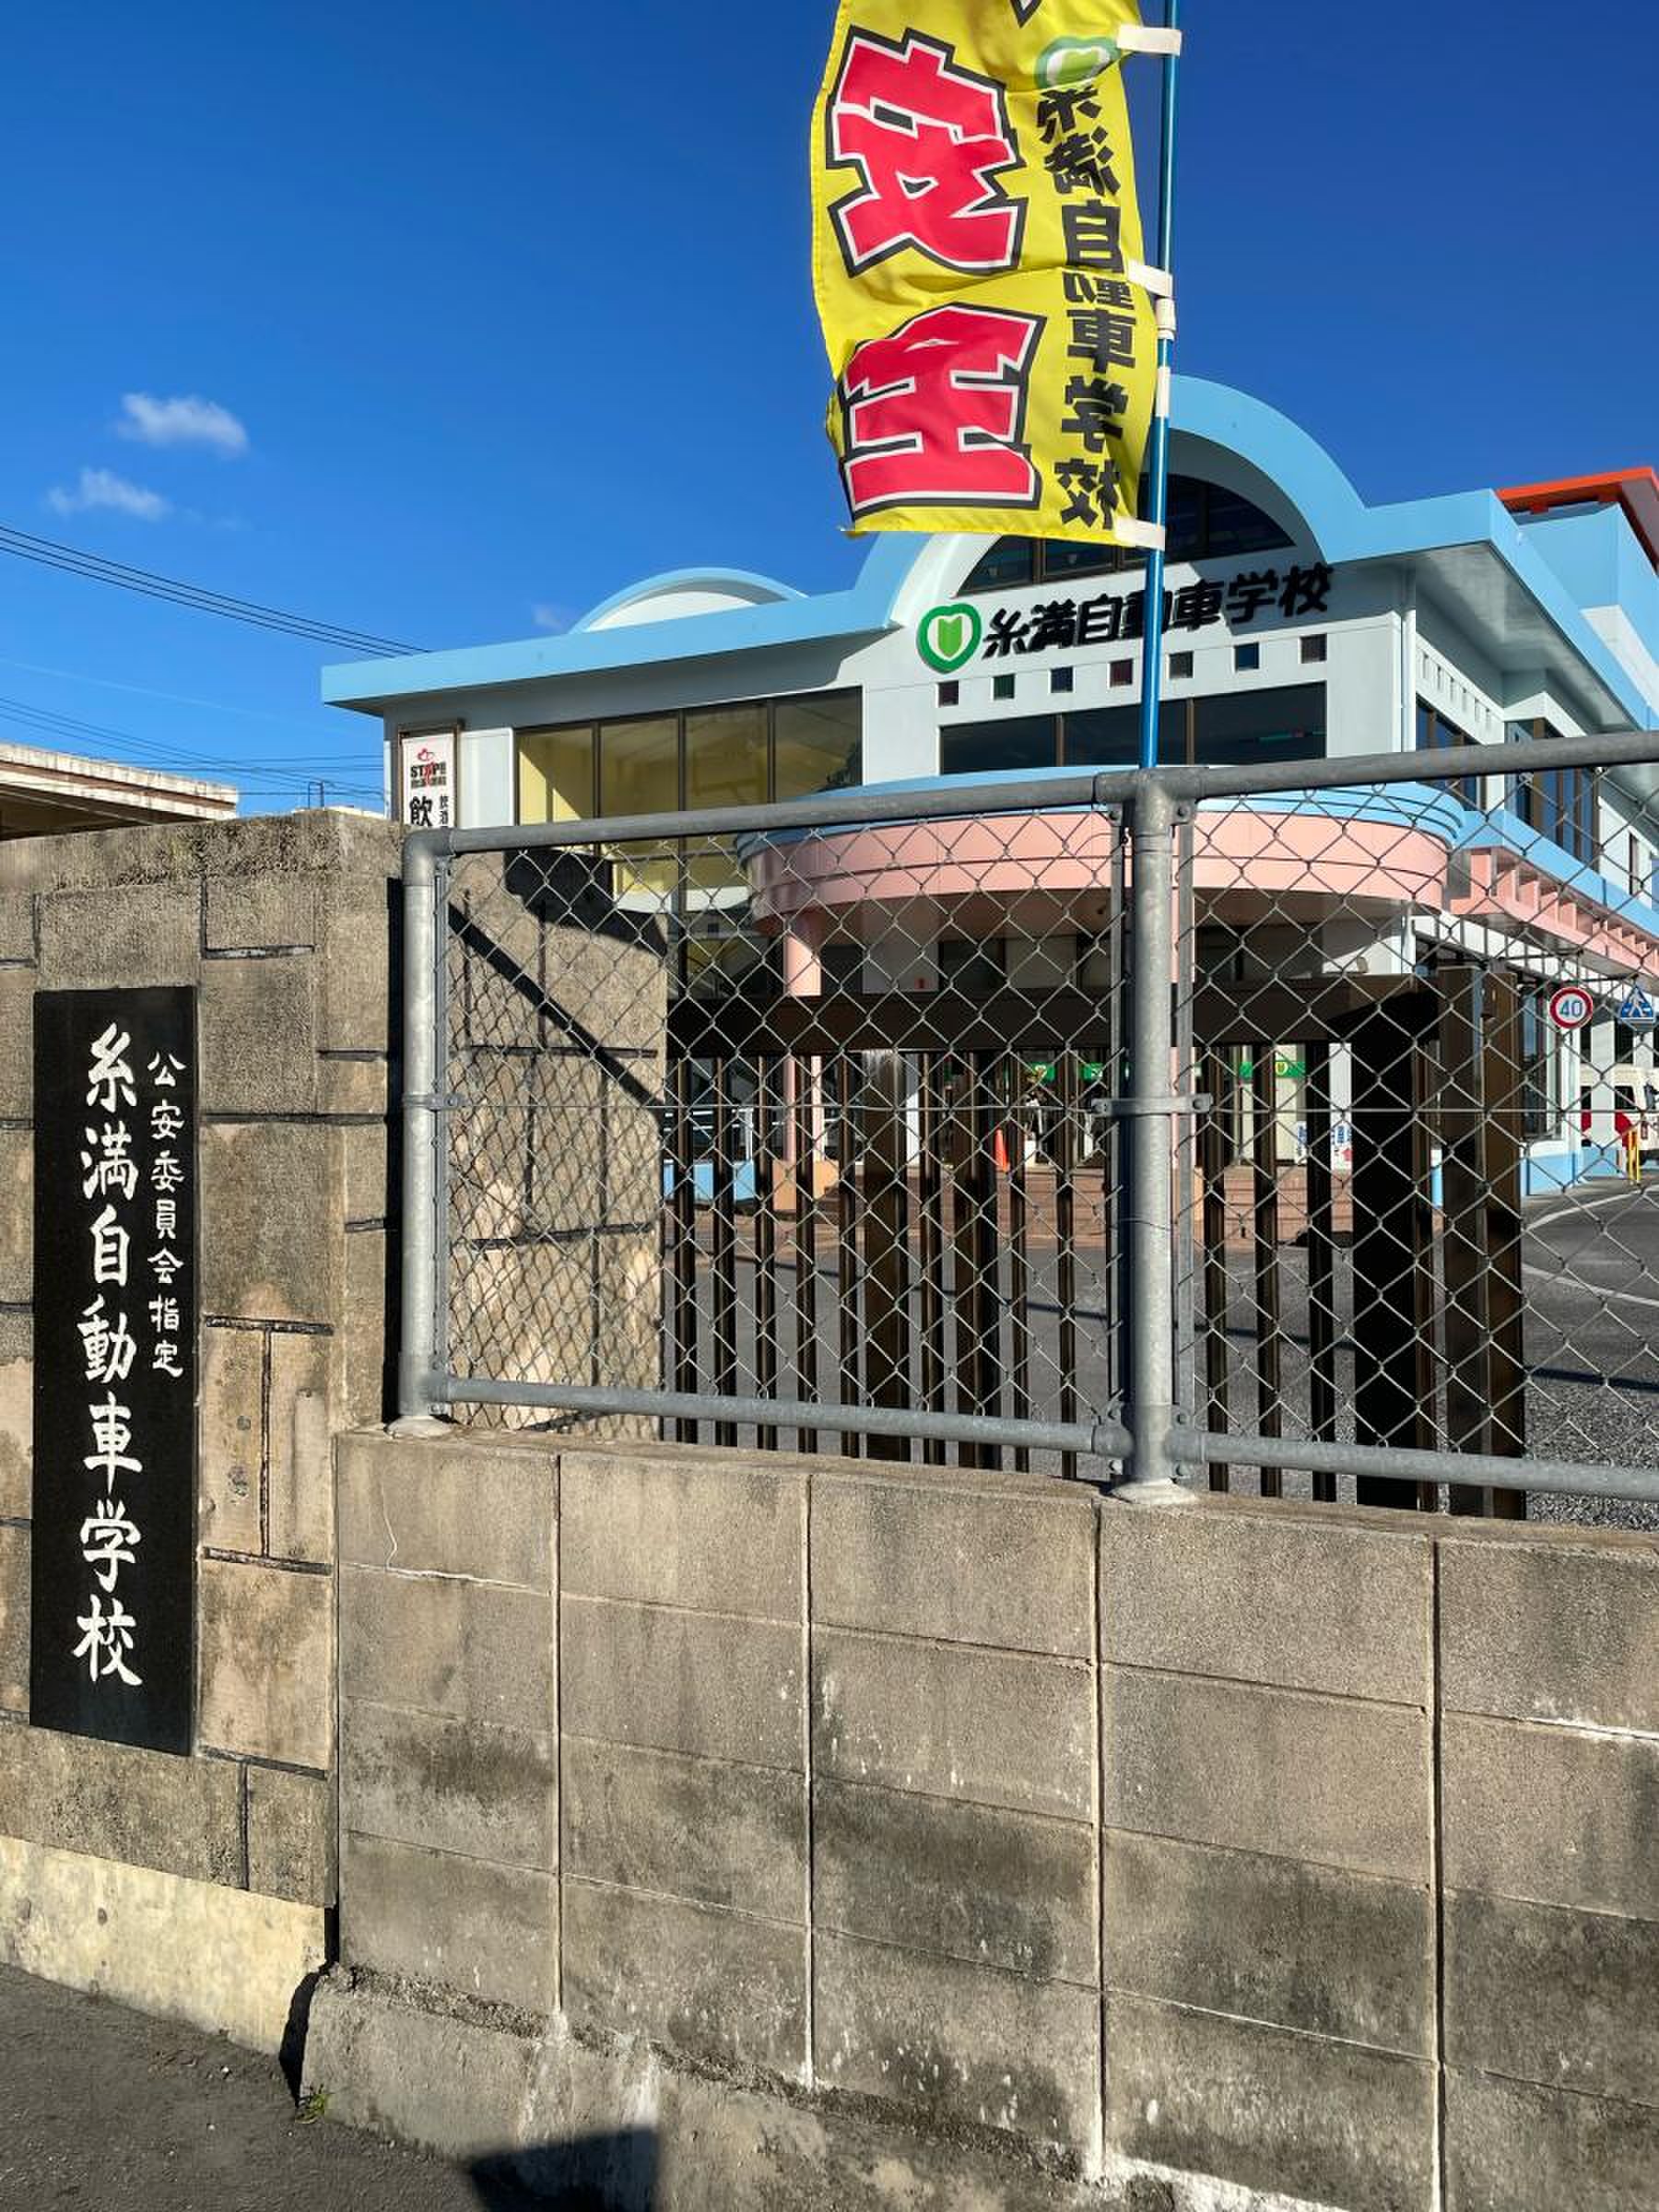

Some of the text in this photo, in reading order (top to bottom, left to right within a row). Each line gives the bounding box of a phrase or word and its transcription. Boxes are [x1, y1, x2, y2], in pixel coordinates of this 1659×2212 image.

[982, 561, 1334, 660] 糸満自動車学校
[1559, 999, 1583, 1018] 40
[147, 1052, 186, 1378] 公安委員会指定
[73, 1023, 142, 1686] 糸満自動車学校
